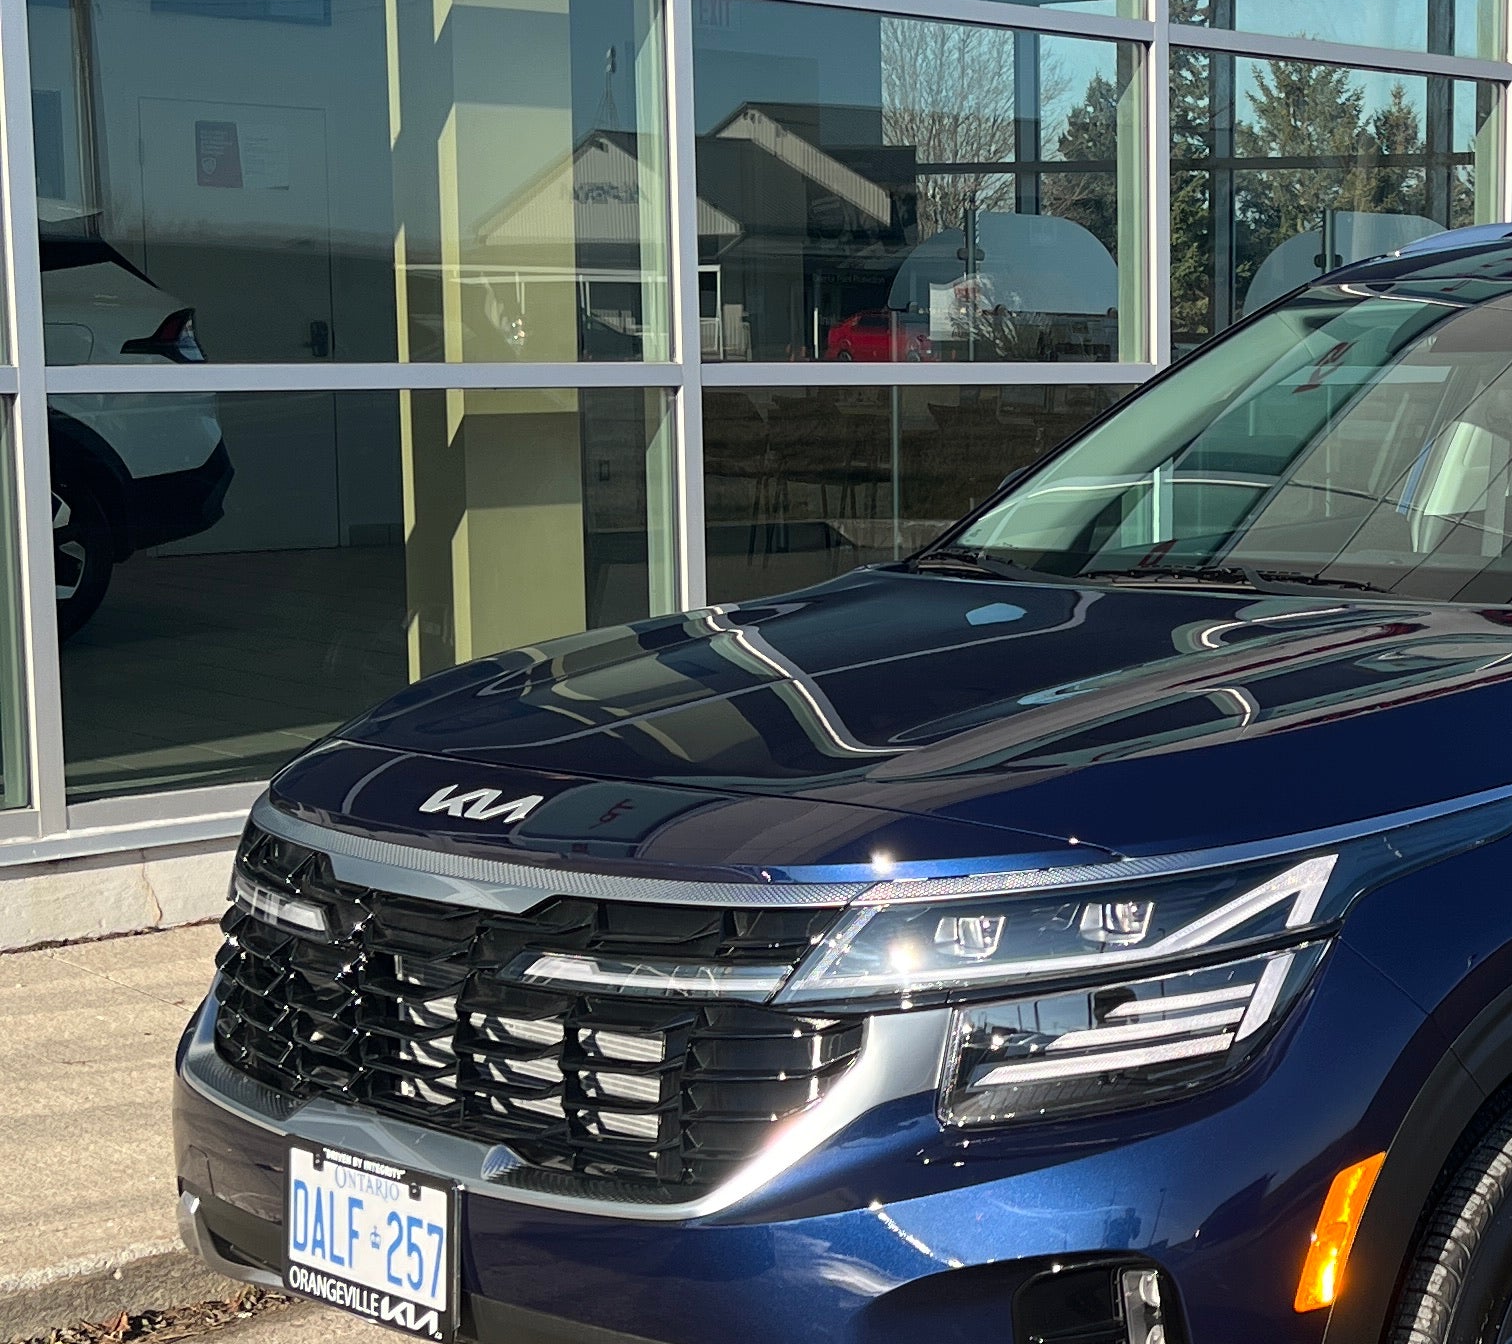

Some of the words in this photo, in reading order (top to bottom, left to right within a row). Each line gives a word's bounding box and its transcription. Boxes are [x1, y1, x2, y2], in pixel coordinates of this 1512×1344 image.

[418, 783, 544, 824] KIA
[334, 1164, 400, 1202] ONTARIO
[293, 1178, 364, 1269] DALF
[386, 1210, 444, 1298] 257
[289, 1265, 379, 1318] ORANGEVILLE
